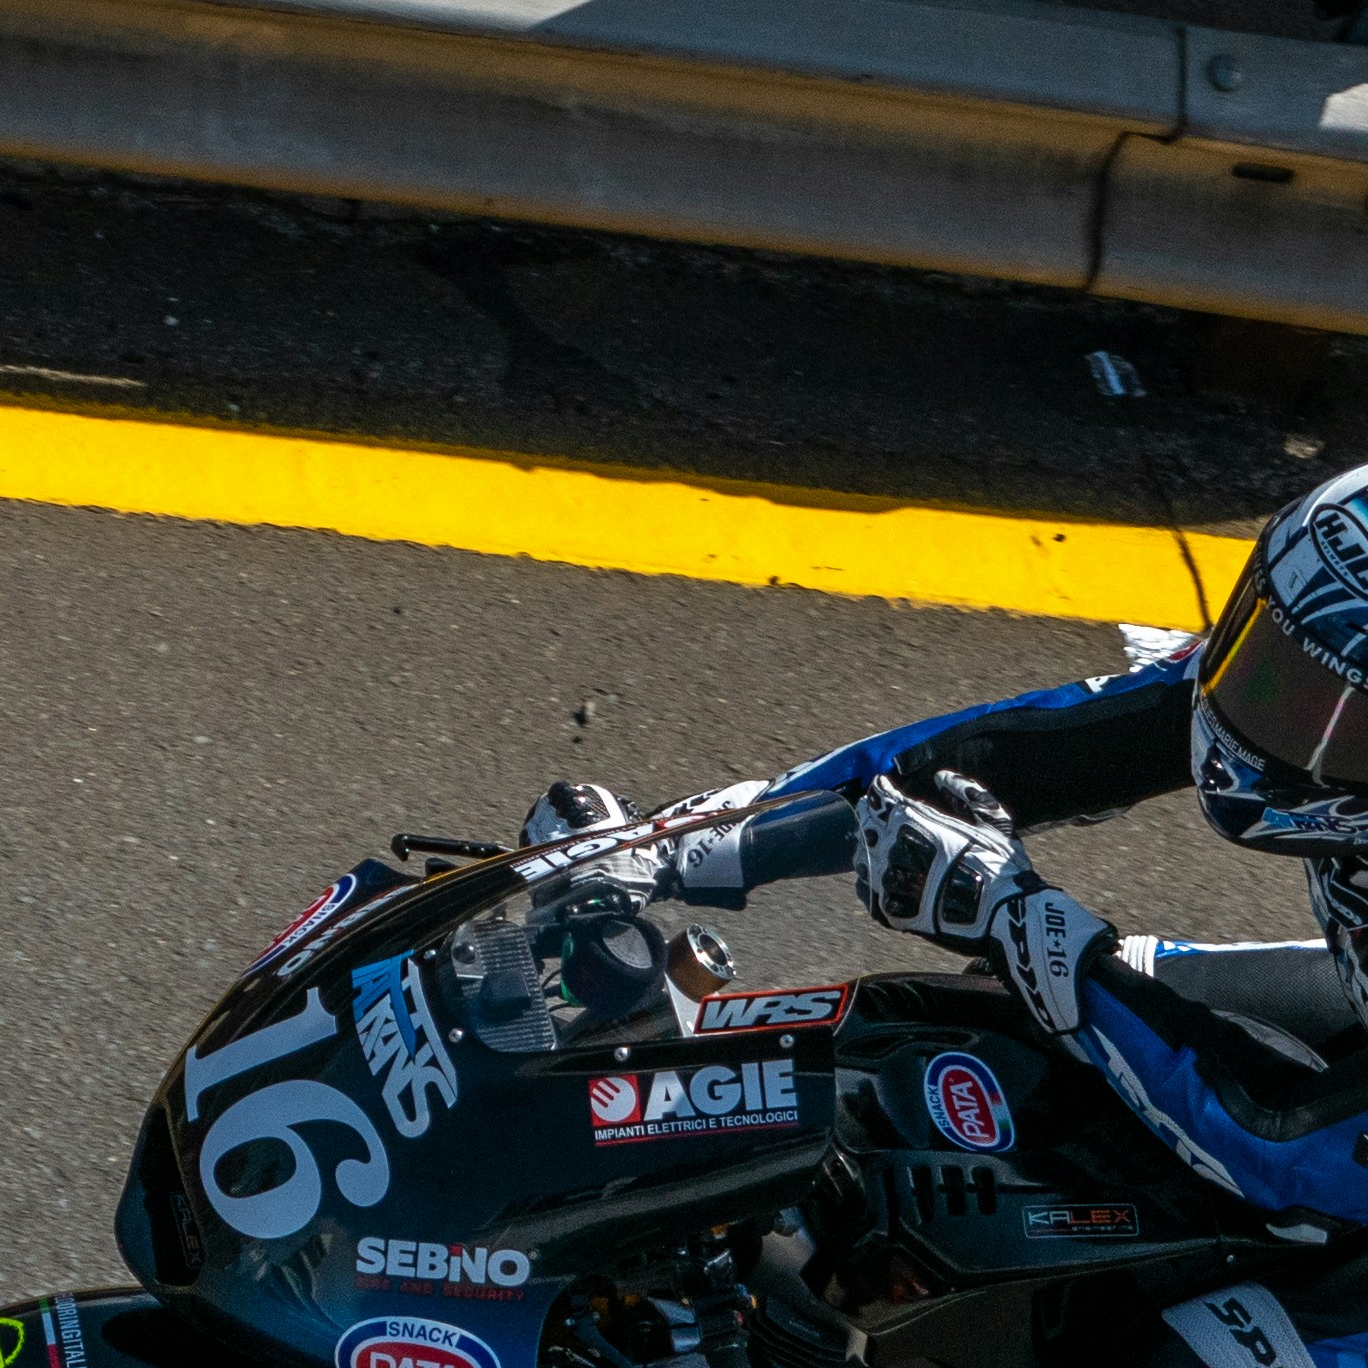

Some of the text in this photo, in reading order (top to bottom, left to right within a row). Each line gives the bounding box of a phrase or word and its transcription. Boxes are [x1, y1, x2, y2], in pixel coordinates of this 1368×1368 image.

[1267, 595, 1296, 635] YOU
[1237, 747, 1266, 771] MAGE
[283, 901, 336, 948] SNACK
[701, 990, 840, 1030] WRS
[643, 1058, 798, 1122] AGIE
[929, 1084, 952, 1129] SNACK
[184, 987, 389, 1239] 16
[594, 1110, 798, 1141] IMPIANTI ELETTRICI E TECNOLOGICI
[961, 1080, 990, 1141] PATA
[1028, 1208, 1132, 1226] KALEX
[388, 1321, 457, 1346] SNACK
